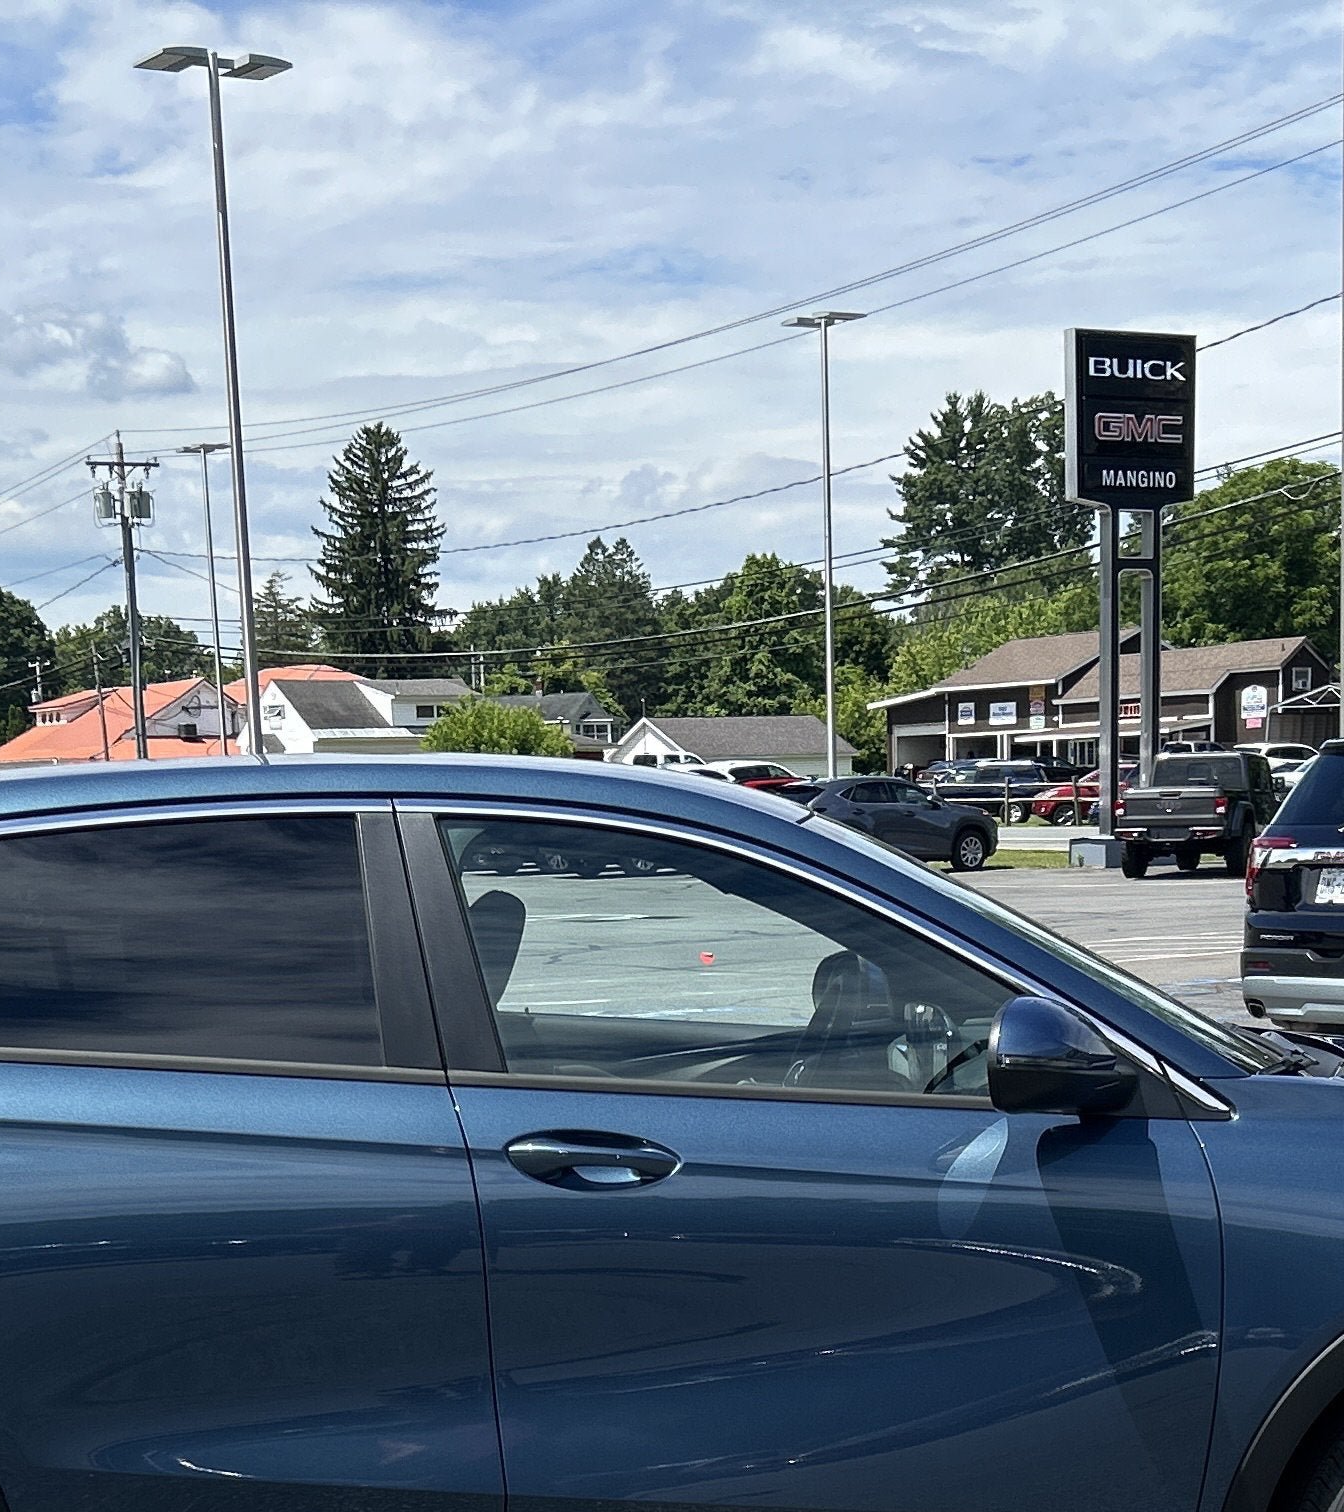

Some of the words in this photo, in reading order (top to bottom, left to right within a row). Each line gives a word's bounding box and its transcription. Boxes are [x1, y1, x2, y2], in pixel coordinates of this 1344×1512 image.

[1088, 357, 1186, 381] BUICK
[1094, 412, 1183, 443] GMC
[1102, 469, 1176, 488] MANGINO
